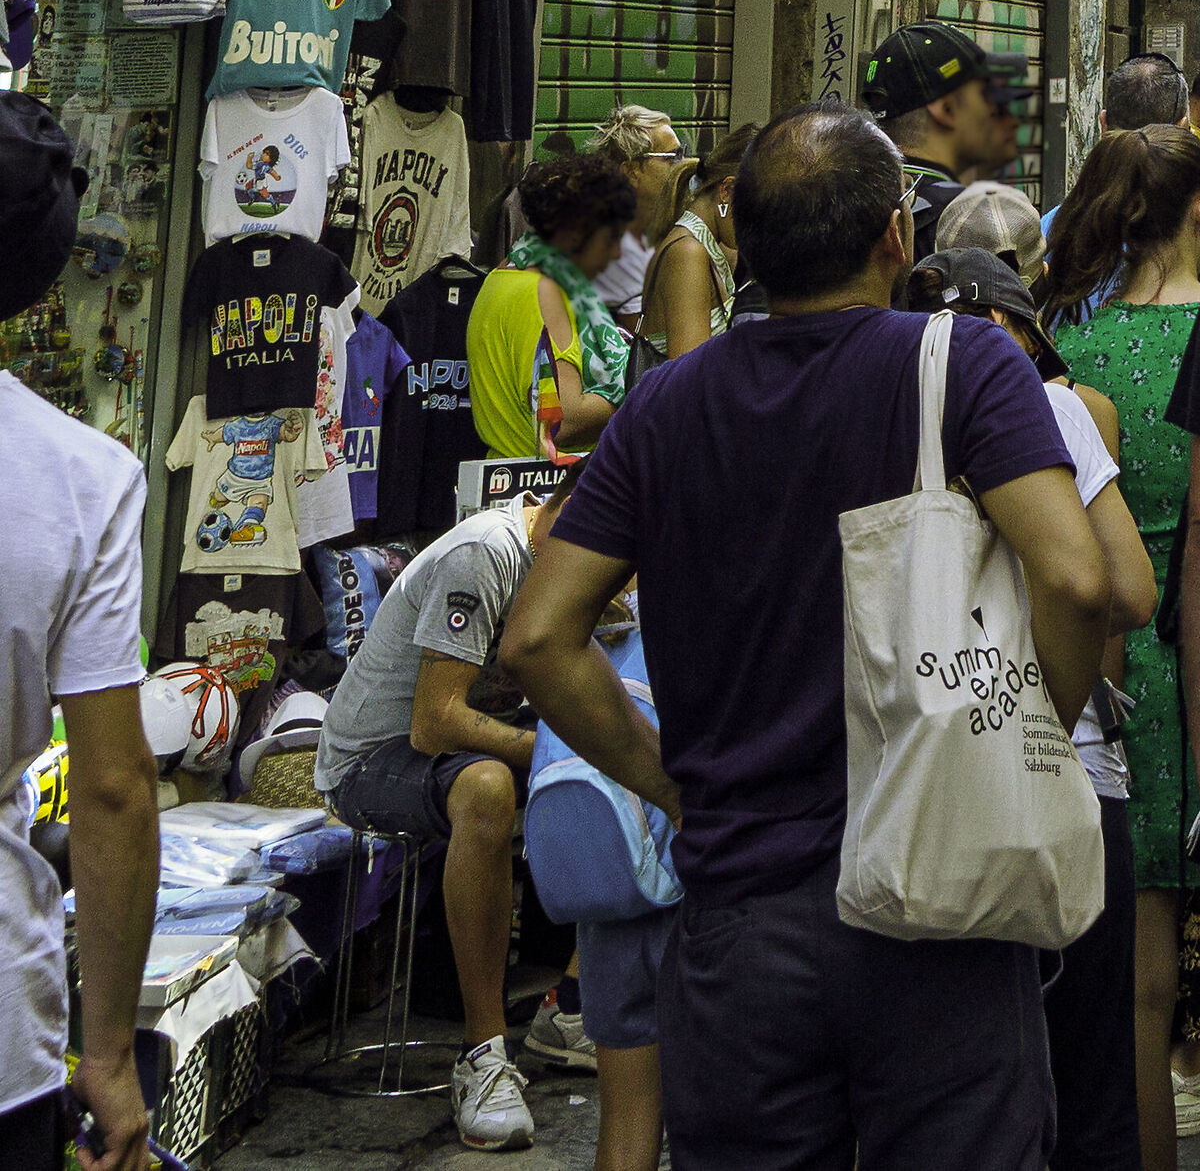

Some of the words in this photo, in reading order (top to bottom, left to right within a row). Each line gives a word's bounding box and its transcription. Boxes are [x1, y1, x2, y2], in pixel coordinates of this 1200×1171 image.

[284, 133, 309, 160] DIOS
[373, 149, 449, 198] NAPOLI
[226, 347, 295, 370] ITALIA
[237, 439, 270, 455] Napoli
[519, 469, 567, 488] ITALIA
[969, 659, 1049, 736] acade
[1023, 742, 1036, 755] für
[1024, 758, 1061, 777] Salzburg
